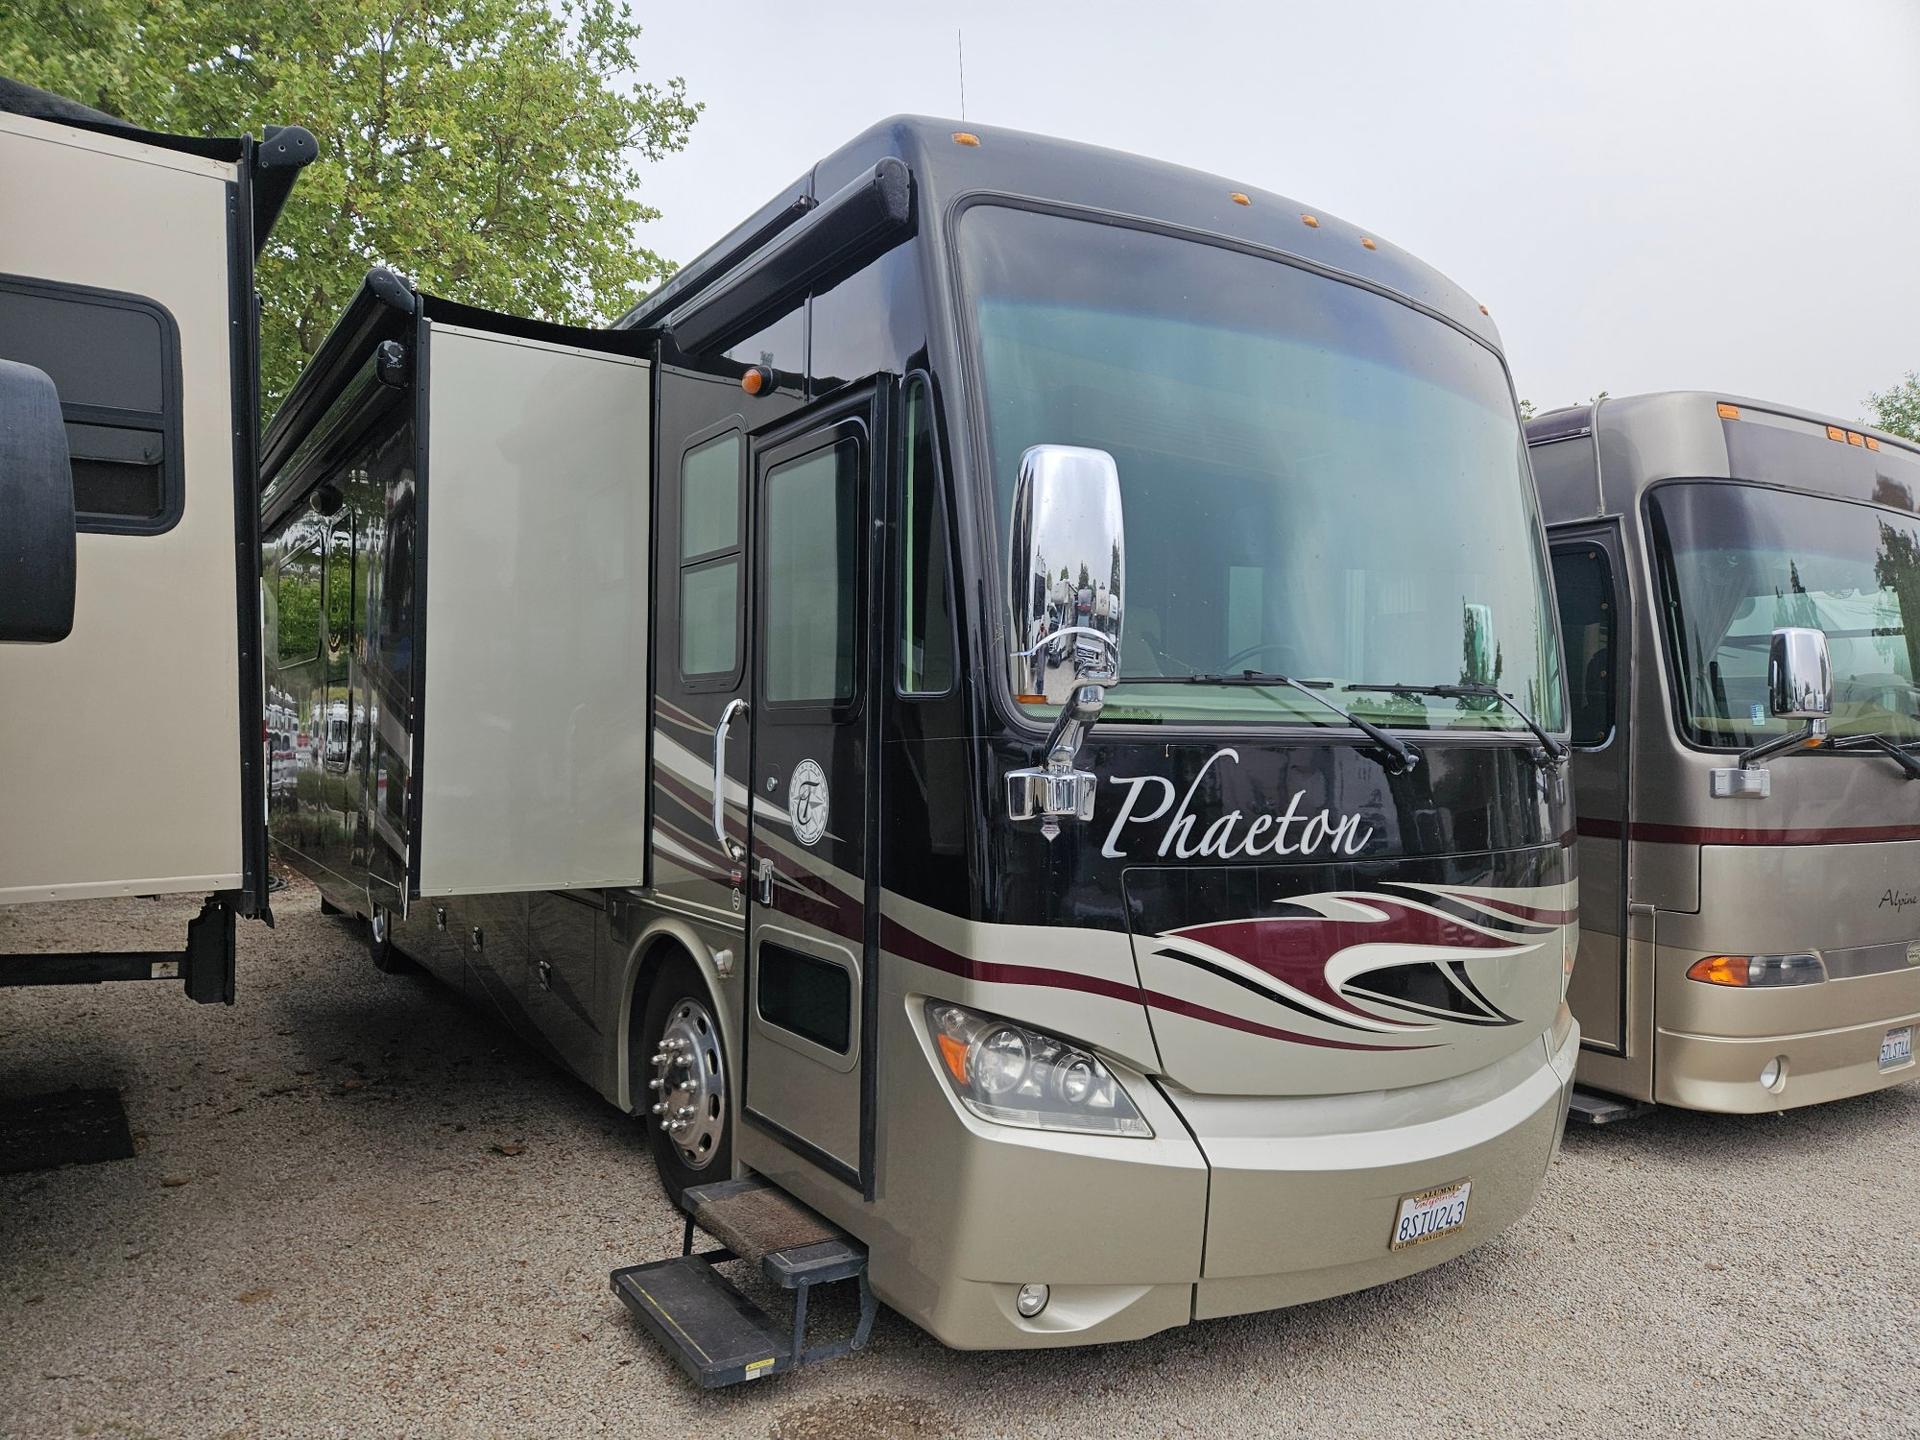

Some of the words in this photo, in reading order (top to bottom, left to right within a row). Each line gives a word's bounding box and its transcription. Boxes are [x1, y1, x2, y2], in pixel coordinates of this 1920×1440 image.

[1101, 748, 1374, 859] Phaeton
[1878, 889, 1917, 912] Alpine
[1422, 1185, 1456, 1199] ALUMNI
